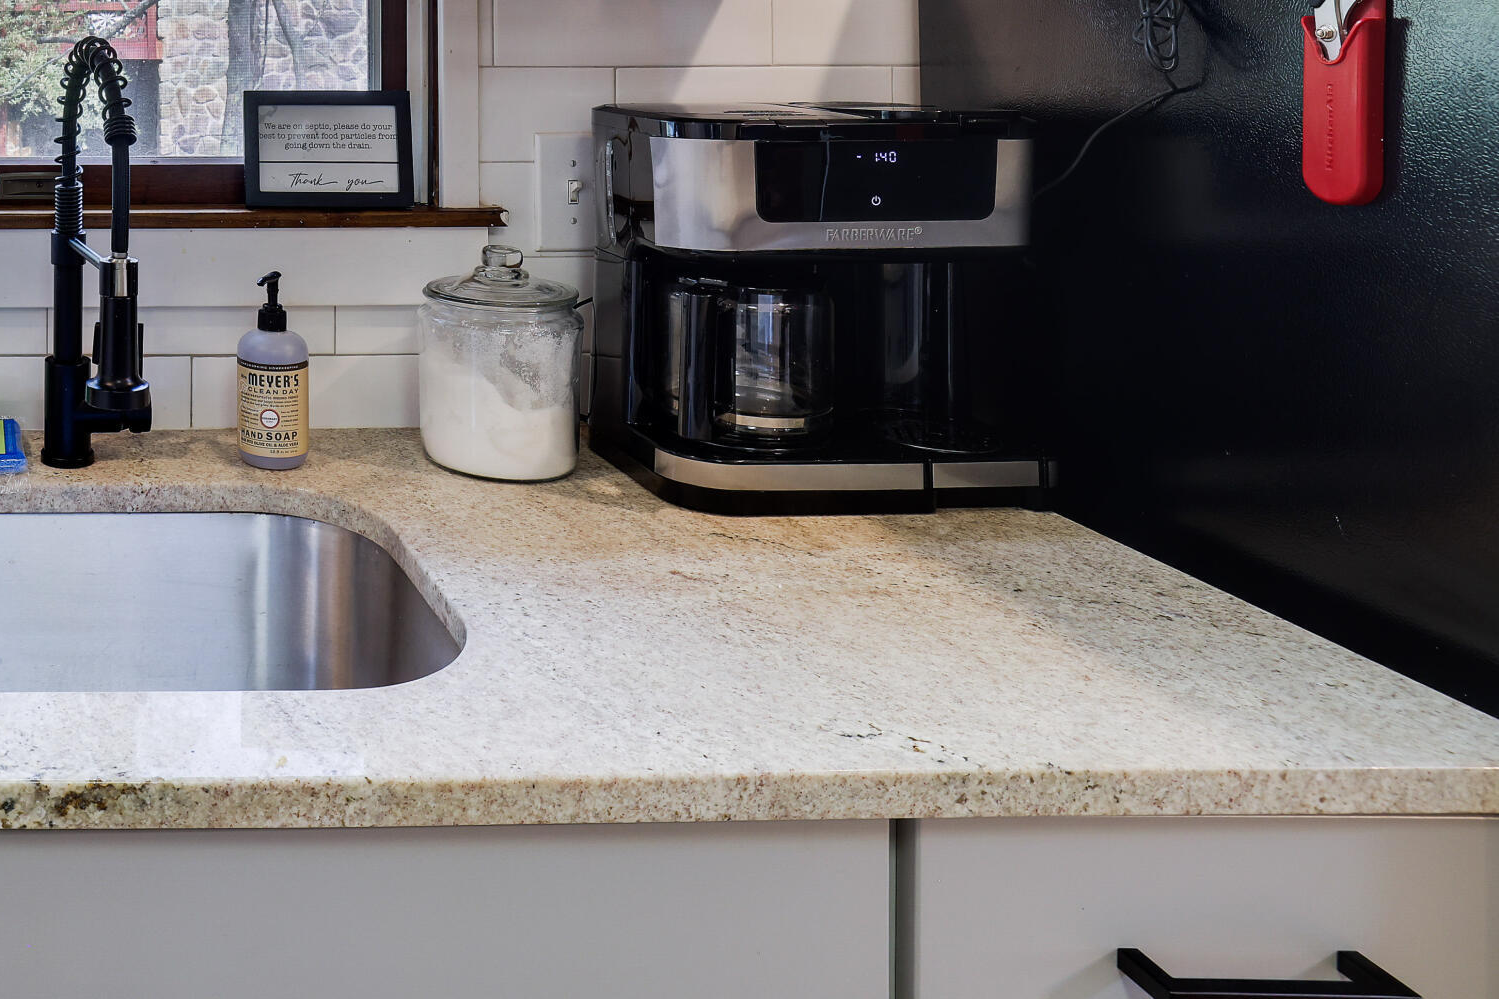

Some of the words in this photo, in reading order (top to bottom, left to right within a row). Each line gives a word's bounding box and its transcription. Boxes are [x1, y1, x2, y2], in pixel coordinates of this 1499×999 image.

[264, 122, 276, 130] We
[333, 122, 359, 131] please
[360, 122, 371, 130] do
[287, 132, 320, 141] prevent
[321, 132, 338, 140] food
[340, 132, 377, 141] particles
[284, 142, 308, 151] going
[332, 141, 346, 149] the
[288, 172, 339, 188] Thank
[345, 177, 384, 192] you
[248, 372, 299, 388] MEYER'S
[247, 386, 279, 395] CLEAN
[241, 429, 263, 440] HAND
[266, 431, 298, 441] SOAP
